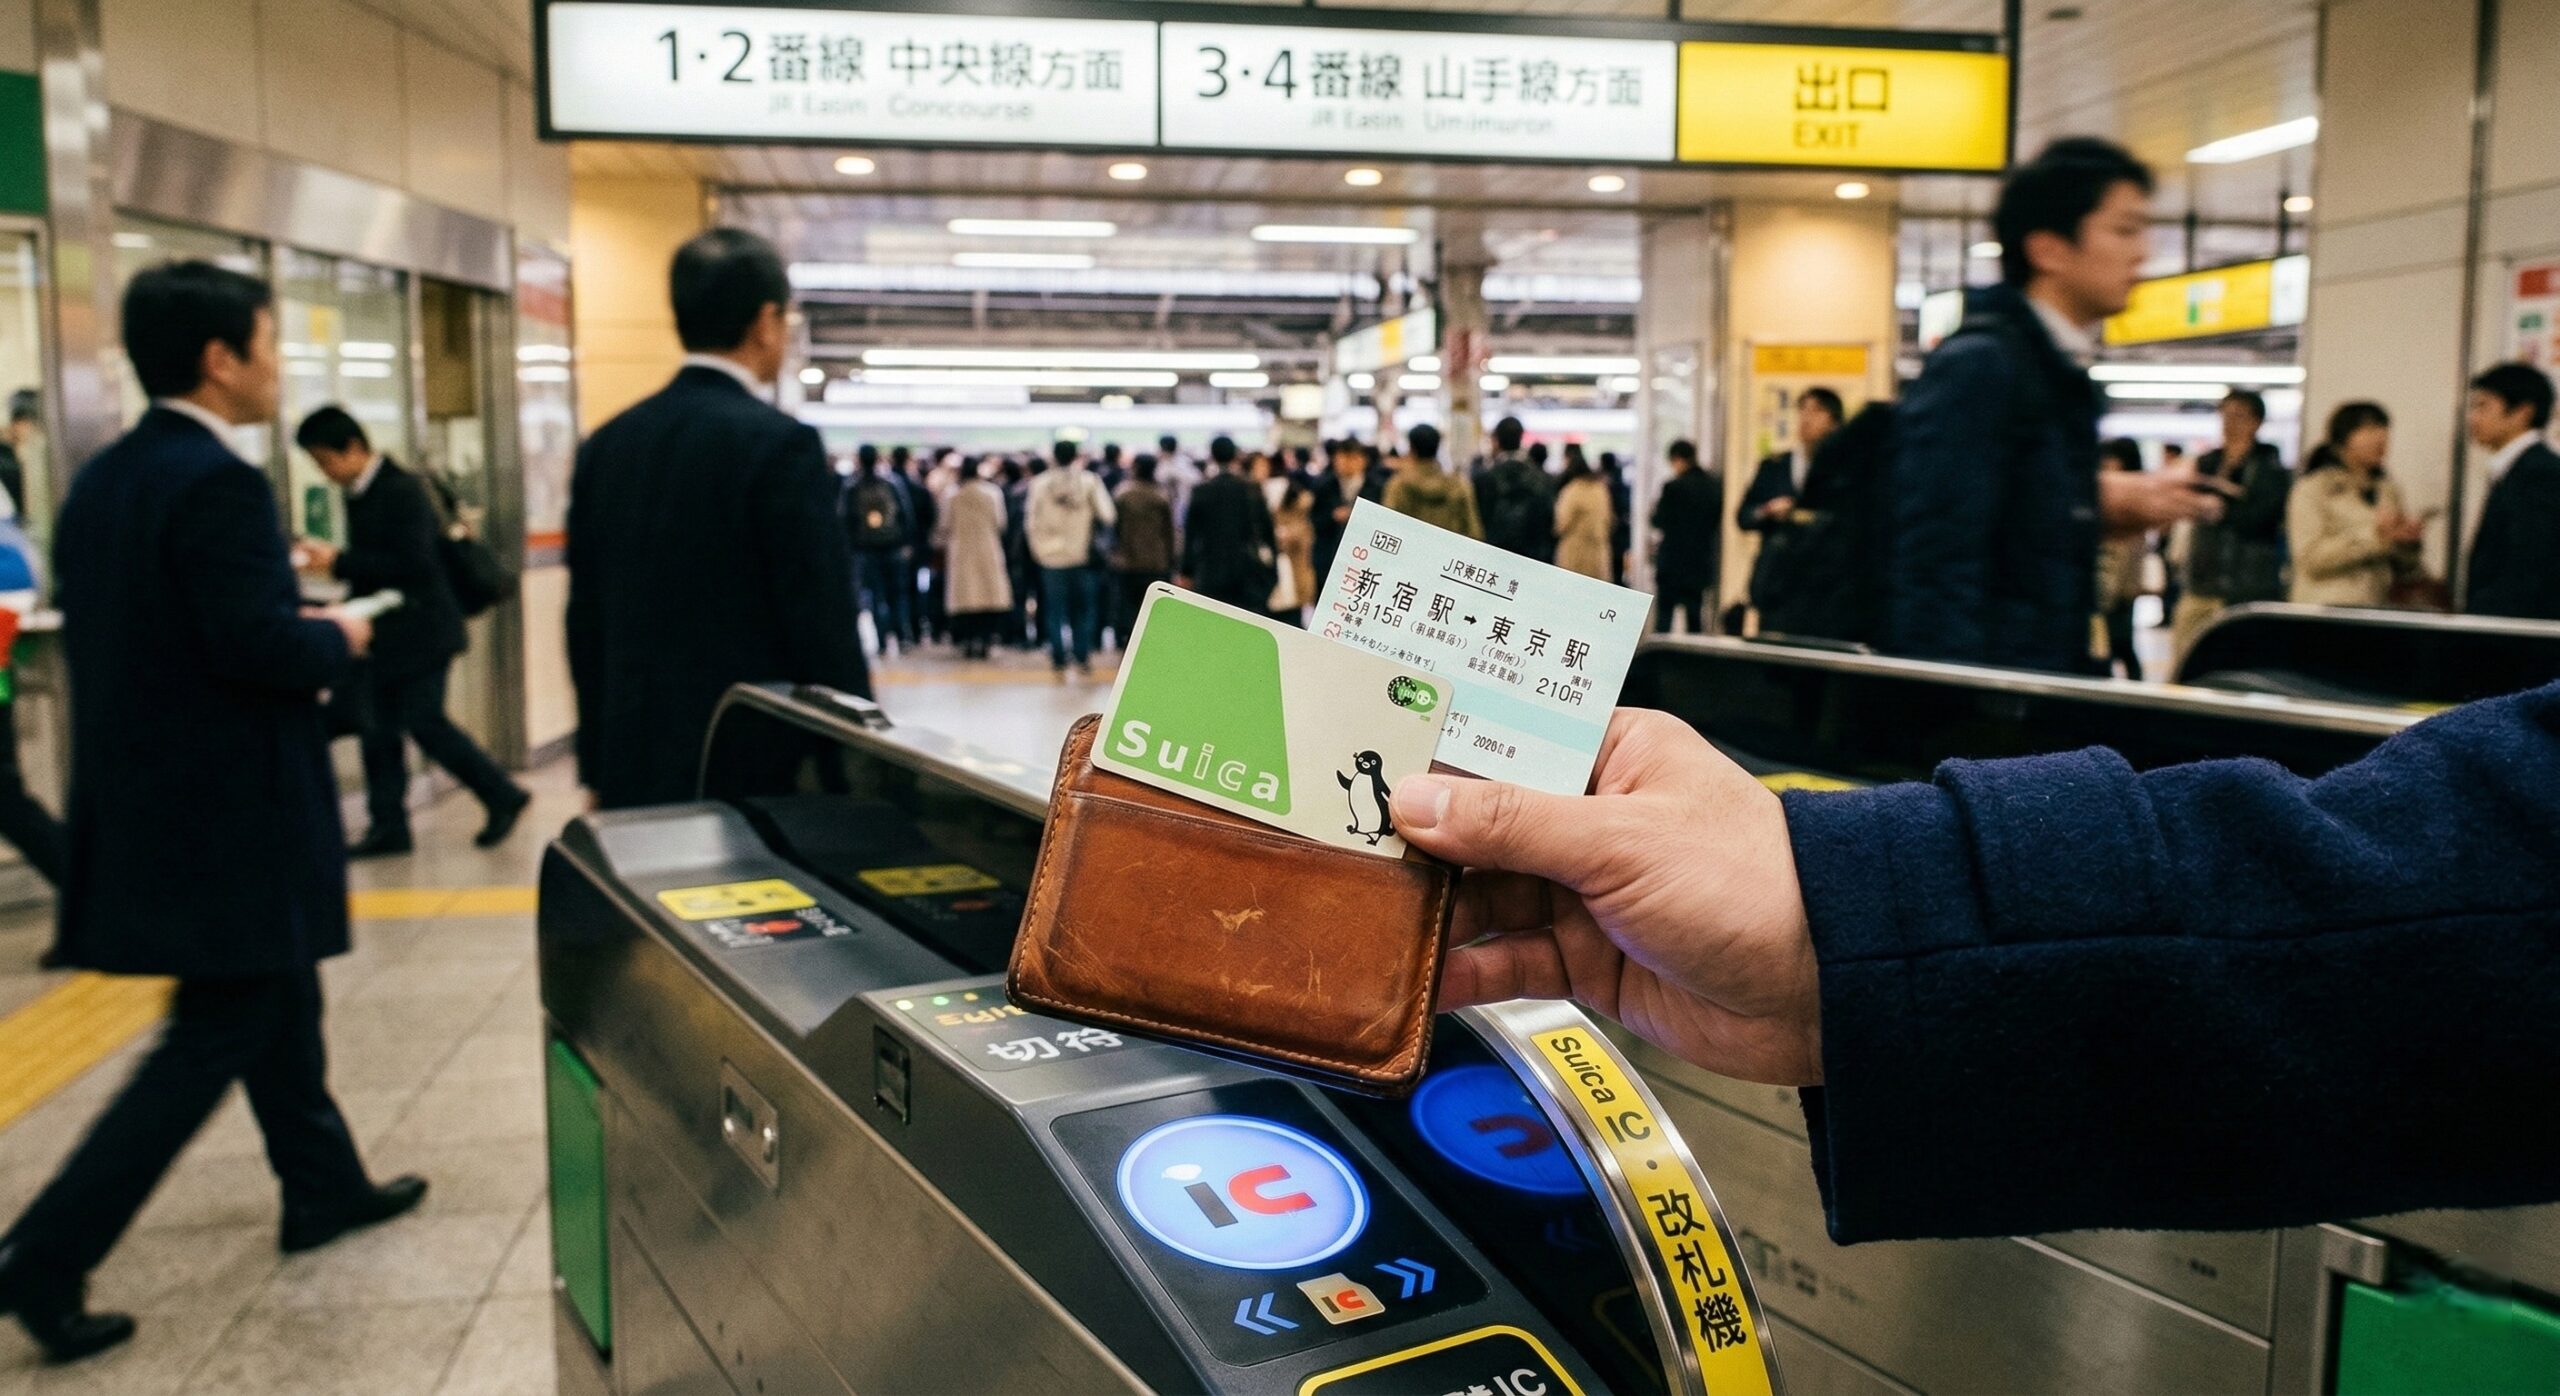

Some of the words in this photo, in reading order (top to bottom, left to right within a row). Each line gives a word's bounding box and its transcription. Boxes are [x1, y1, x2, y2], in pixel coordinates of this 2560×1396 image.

[1795, 62, 1889, 111] 出口
[1793, 121, 1859, 148] EXIT
[1442, 557, 1500, 589] JR東日本
[1348, 594, 1403, 628] 3月15日
[1599, 608, 1618, 623] JR
[1535, 677, 1584, 706] 210円
[1116, 719, 1280, 802] Suica
[1551, 1035, 1616, 1104] Suica
[1604, 1110, 1651, 1143] IC
[1646, 1188, 1747, 1353] 改札機
